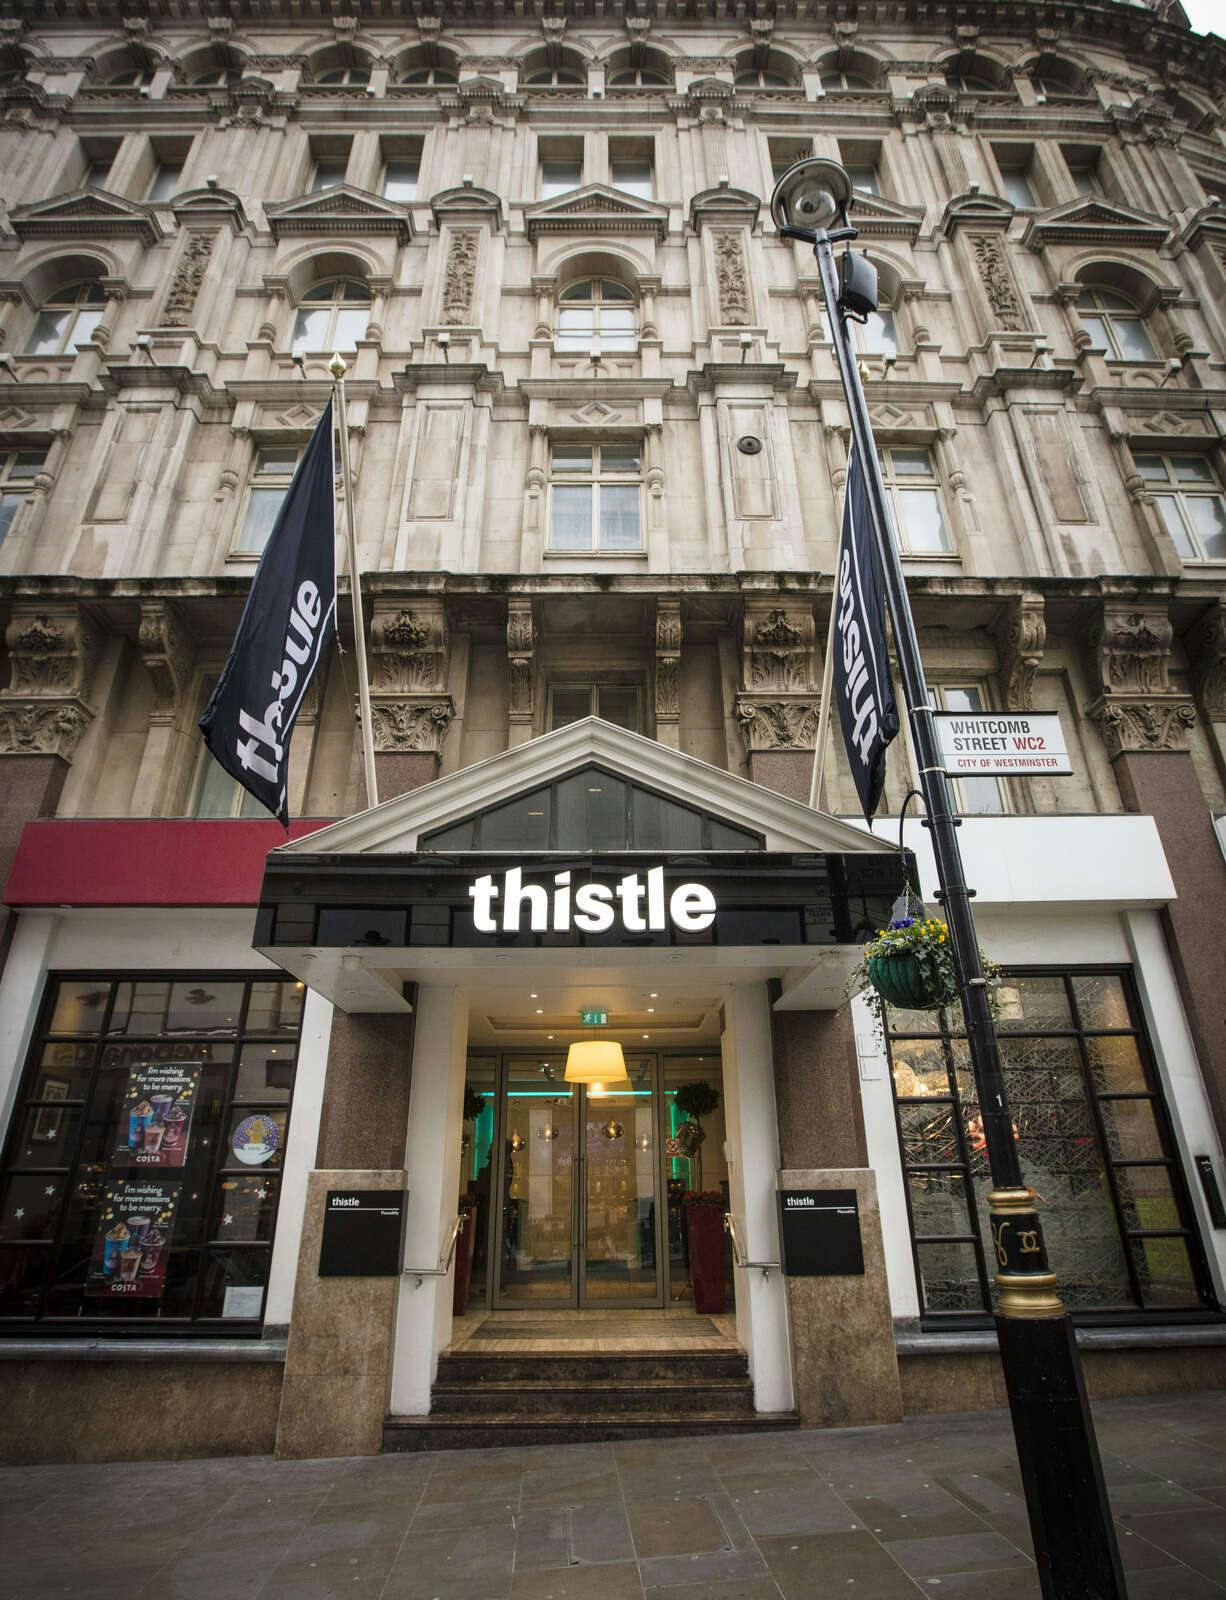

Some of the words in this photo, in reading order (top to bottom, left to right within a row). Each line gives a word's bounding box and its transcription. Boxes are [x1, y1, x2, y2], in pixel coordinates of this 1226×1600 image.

[950, 720, 1031, 734] WHITCOMB
[953, 737, 1007, 750] STREET
[1012, 737, 1046, 750] WC2
[958, 759, 976, 768] CITY
[980, 759, 991, 767] OF
[994, 758, 1058, 767] WESTMINSTER
[468, 866, 717, 934] thistle
[136, 1155, 160, 1163] COSTA
[332, 1197, 360, 1206] thistle
[787, 1196, 814, 1206] thistle
[111, 1284, 137, 1292] COSTA
